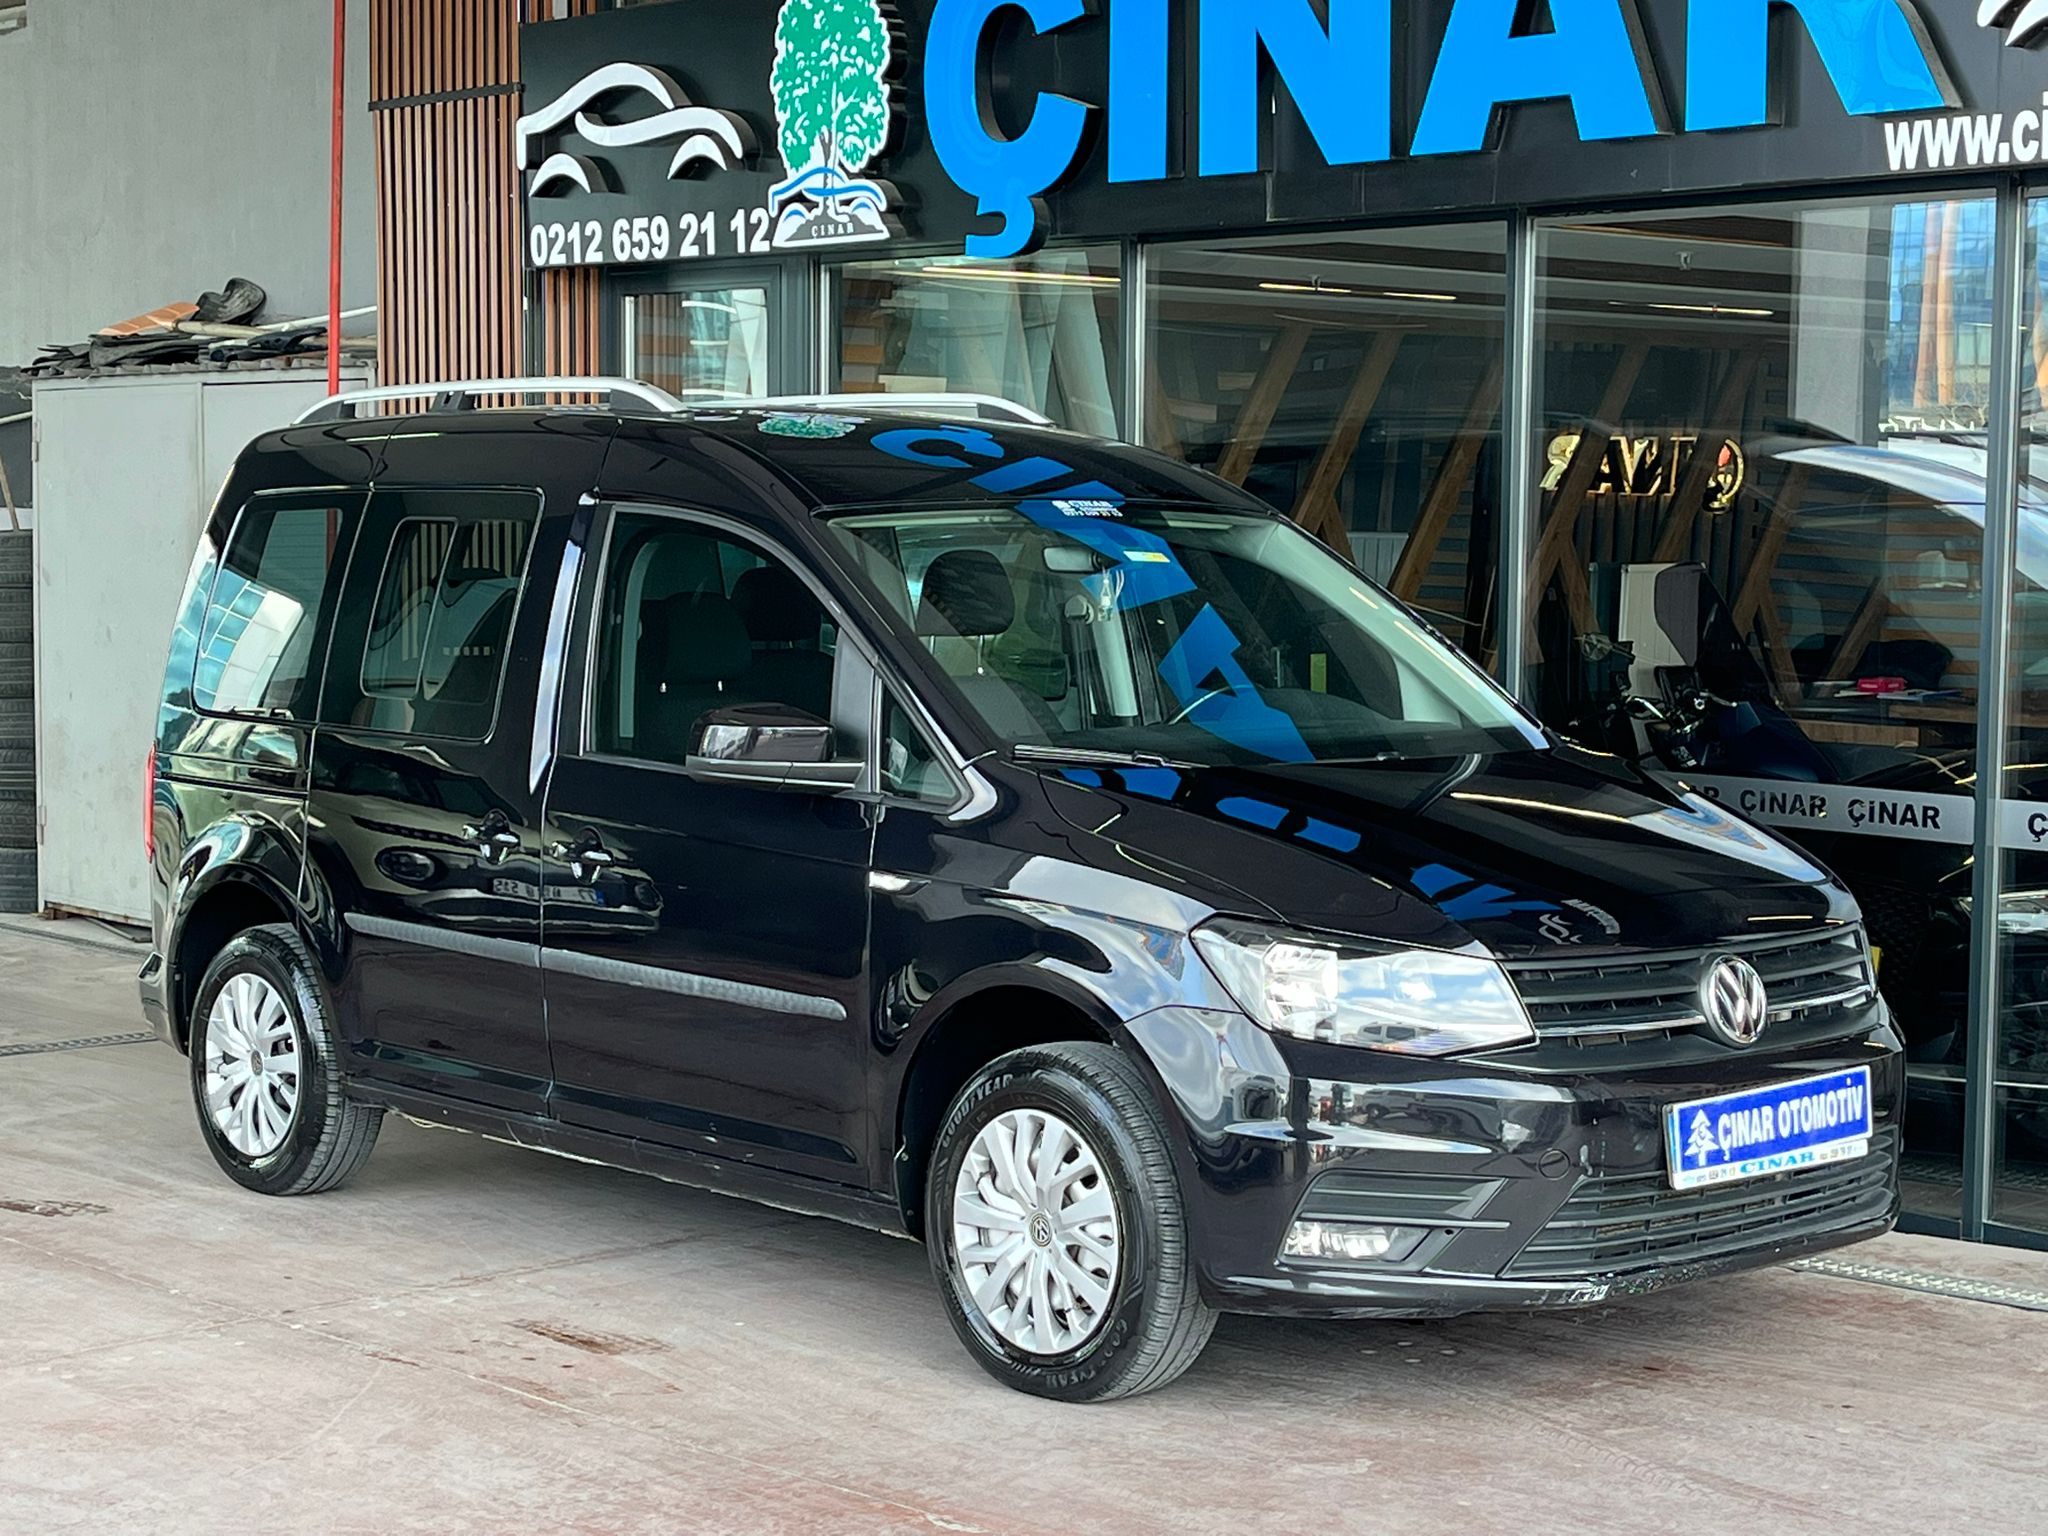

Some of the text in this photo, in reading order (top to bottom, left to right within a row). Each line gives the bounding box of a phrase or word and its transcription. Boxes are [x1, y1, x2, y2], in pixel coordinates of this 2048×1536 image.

[531, 208, 771, 266] 0212 659 21 12
[1717, 1105, 1775, 1162] ÇINAR
